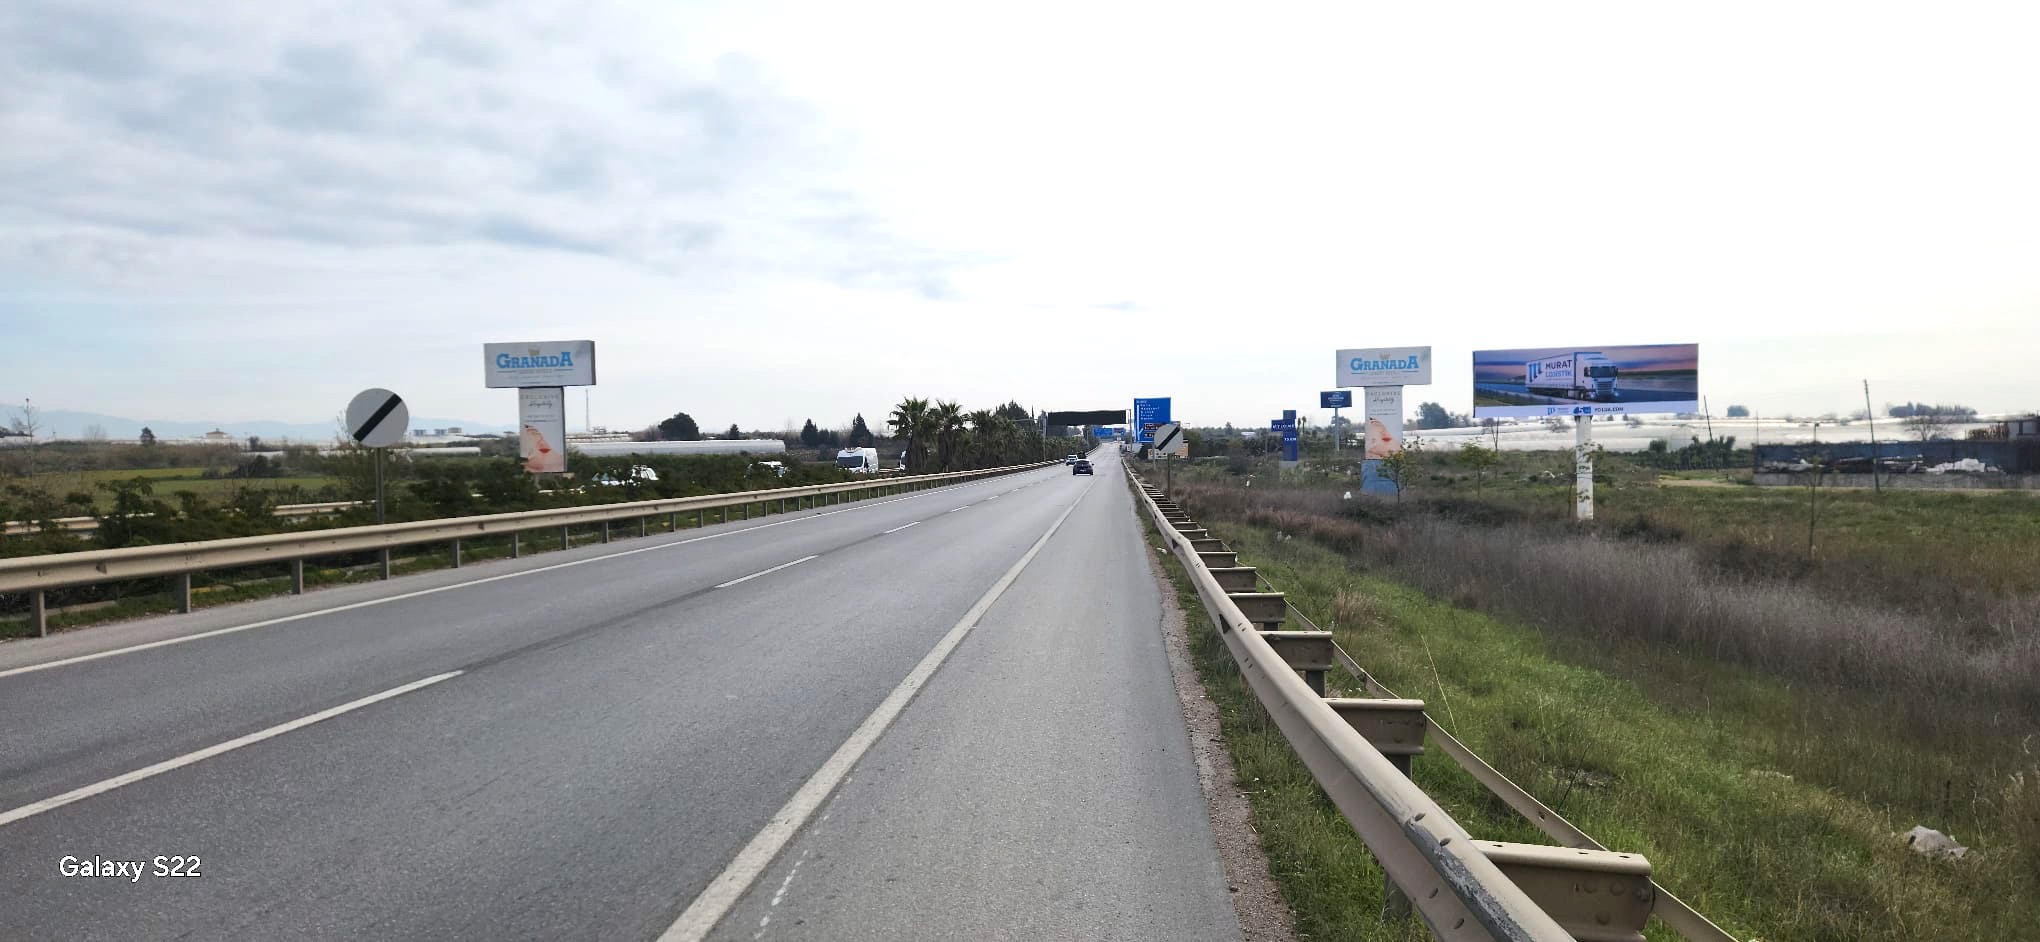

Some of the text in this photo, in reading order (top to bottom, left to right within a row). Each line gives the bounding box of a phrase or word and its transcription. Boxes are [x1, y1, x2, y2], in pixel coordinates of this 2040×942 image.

[496, 351, 573, 369] GRANADA
[1350, 355, 1419, 371] GRANADA
[1545, 359, 1573, 369] MURAT
